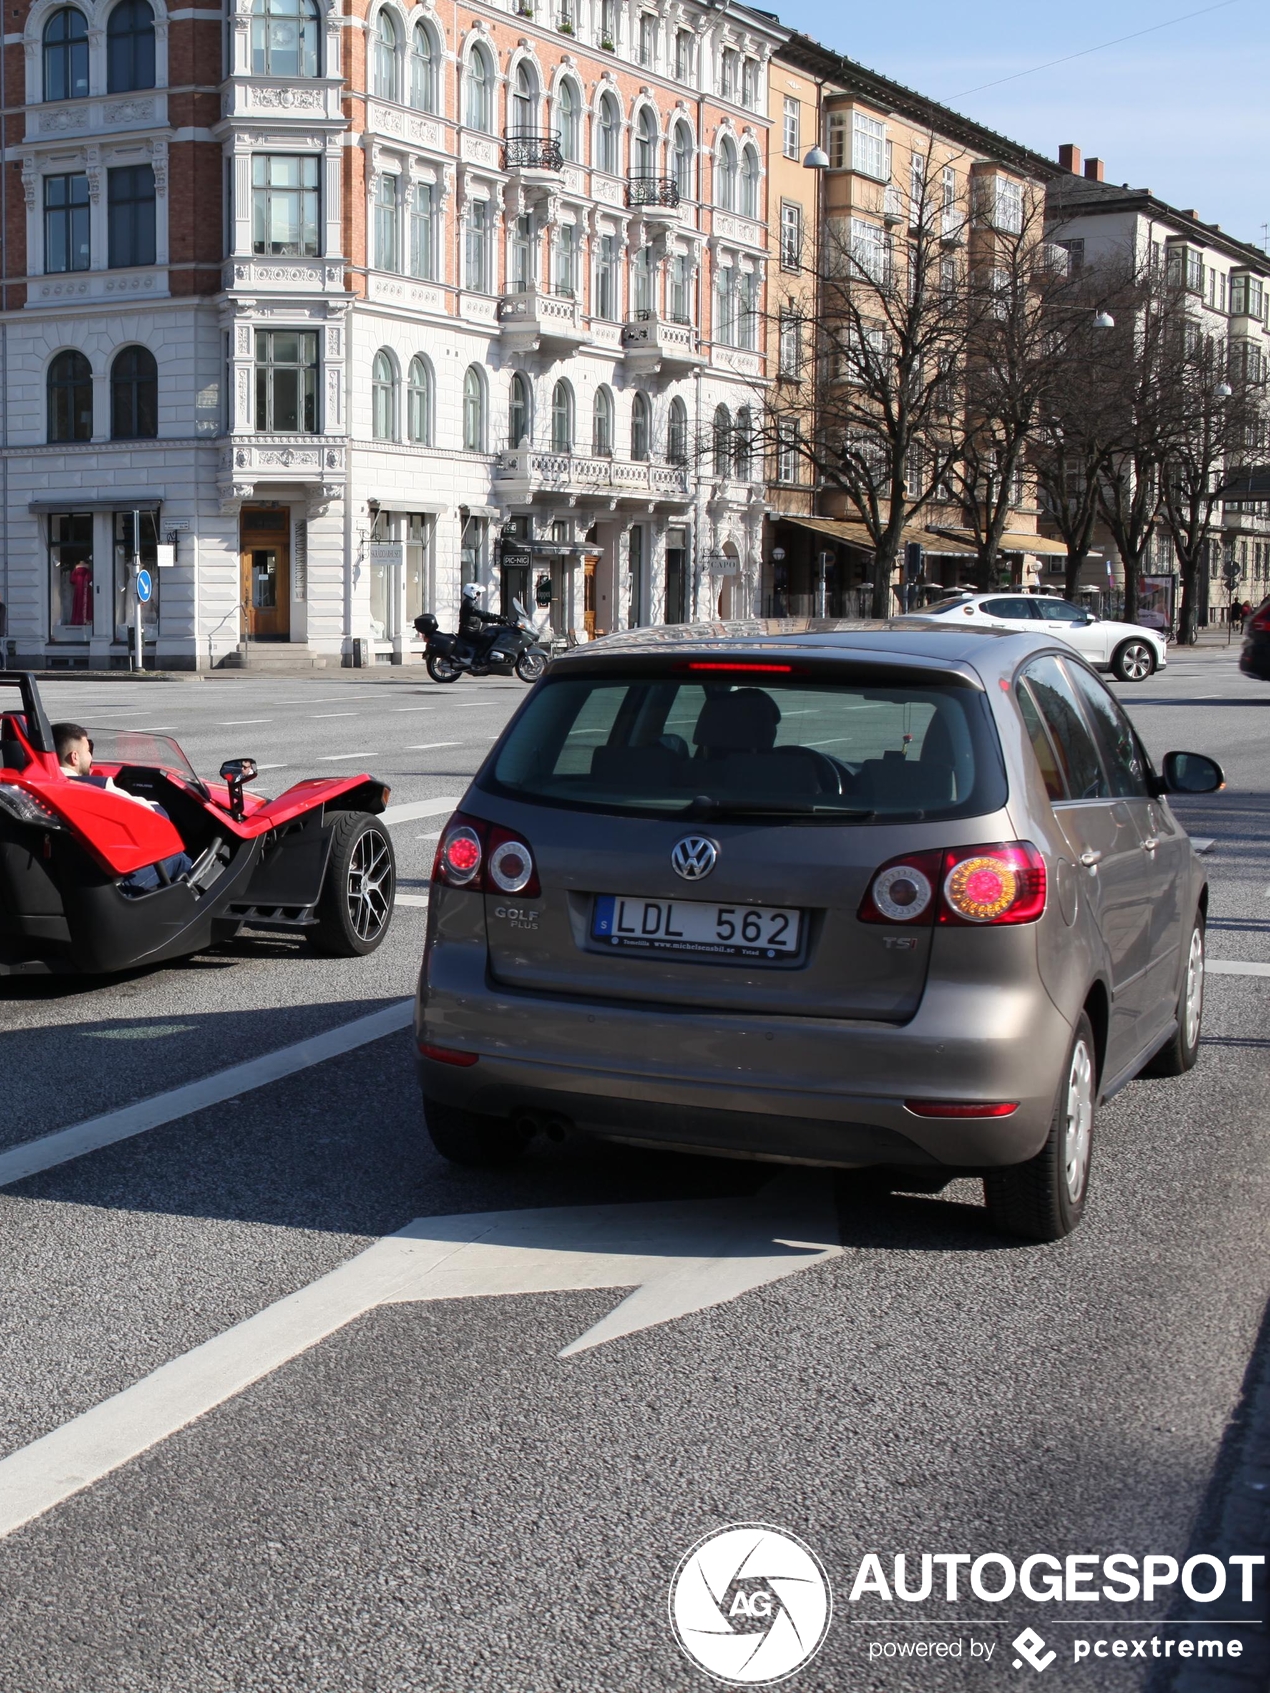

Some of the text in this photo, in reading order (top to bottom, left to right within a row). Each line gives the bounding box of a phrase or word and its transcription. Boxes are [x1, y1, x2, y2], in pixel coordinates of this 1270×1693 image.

[711, 561, 736, 569] CAPO
[495, 906, 539, 921] GOLF
[510, 920, 538, 930] PLUS
[617, 901, 789, 946] LDL 562
[623, 939, 760, 956] Tomelilla www.michelsensbil.se Ystad
[882, 936, 918, 950] TSI
